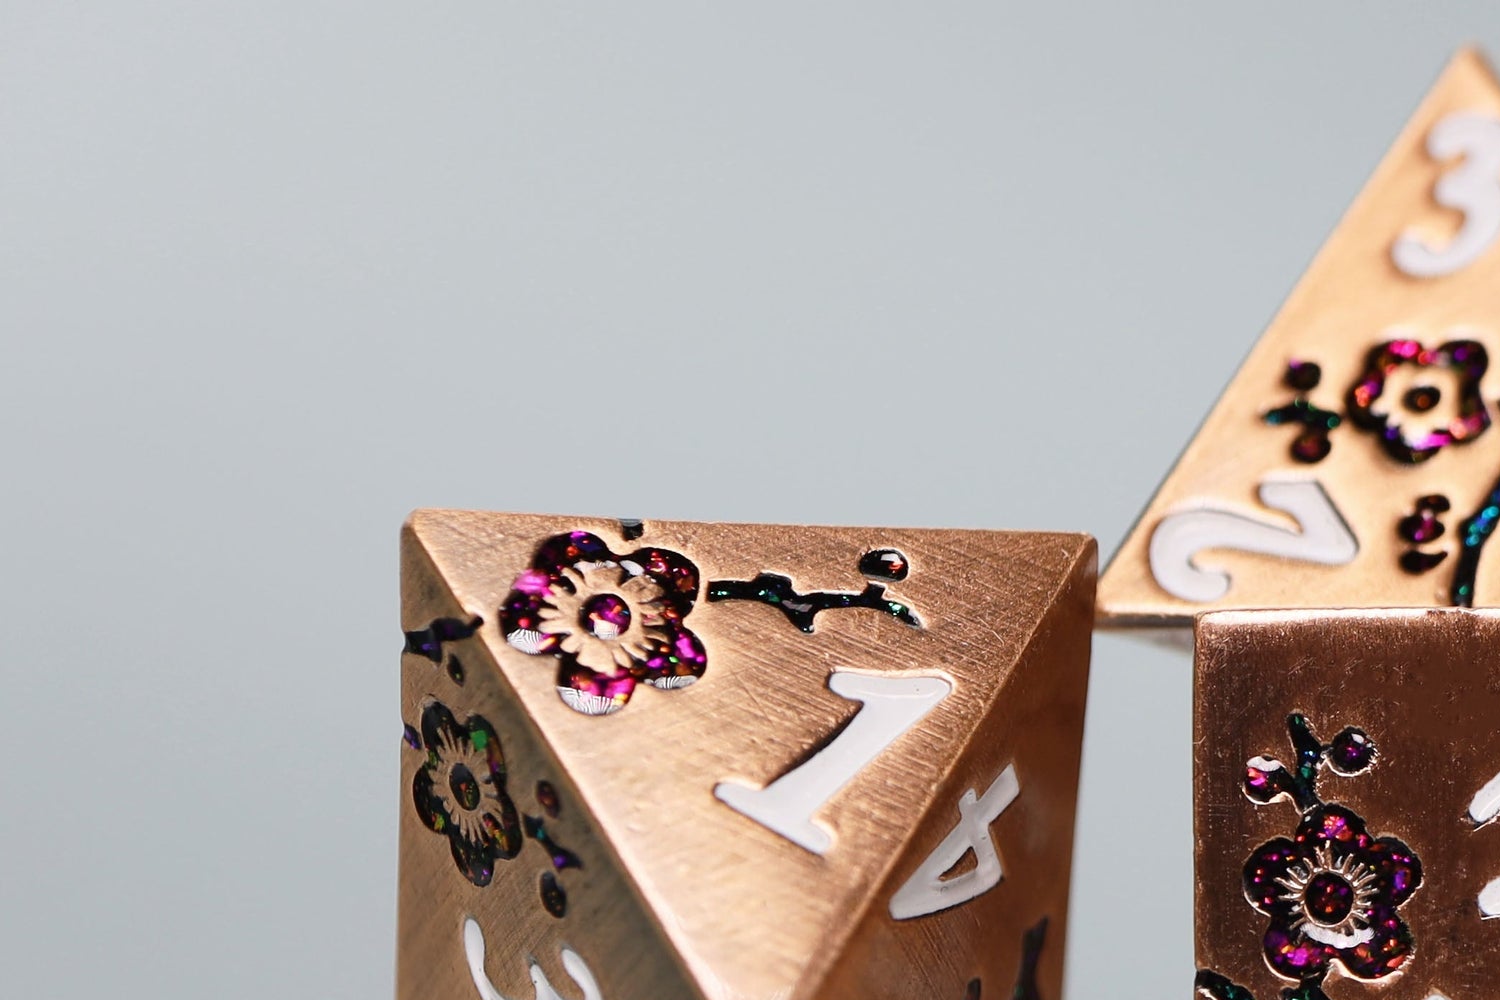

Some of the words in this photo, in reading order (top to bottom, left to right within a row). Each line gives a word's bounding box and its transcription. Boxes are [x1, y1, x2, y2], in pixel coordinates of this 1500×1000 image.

[1149, 478, 1359, 602] 2
[714, 668, 953, 856] 1
[888, 764, 1021, 920] 4
